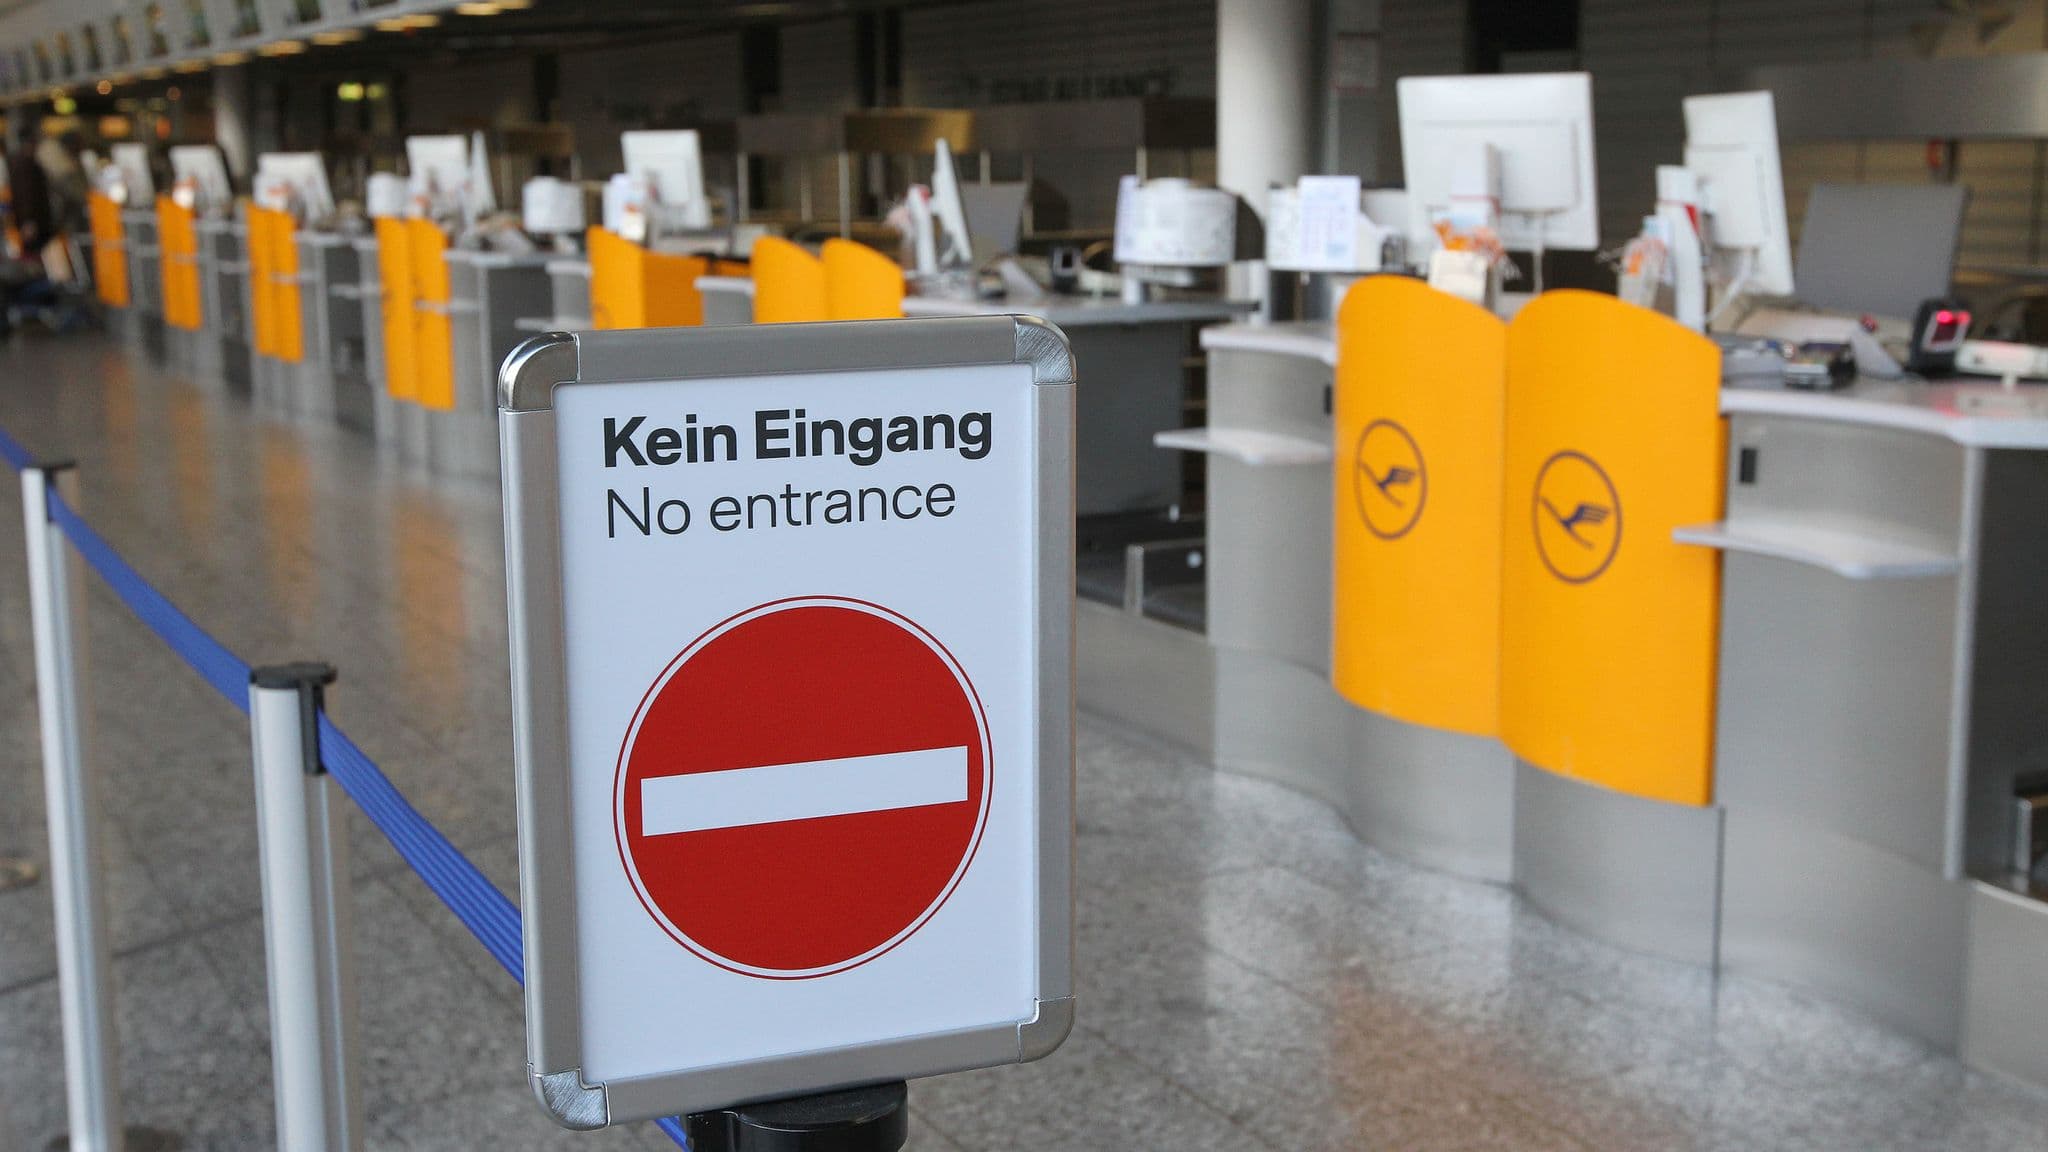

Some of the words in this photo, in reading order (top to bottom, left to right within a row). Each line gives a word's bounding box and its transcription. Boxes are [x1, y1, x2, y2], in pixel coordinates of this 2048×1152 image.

[603, 413, 738, 468] Kein
[754, 408, 992, 467] Eingang
[607, 486, 692, 539] No
[709, 483, 956, 532] entrance
